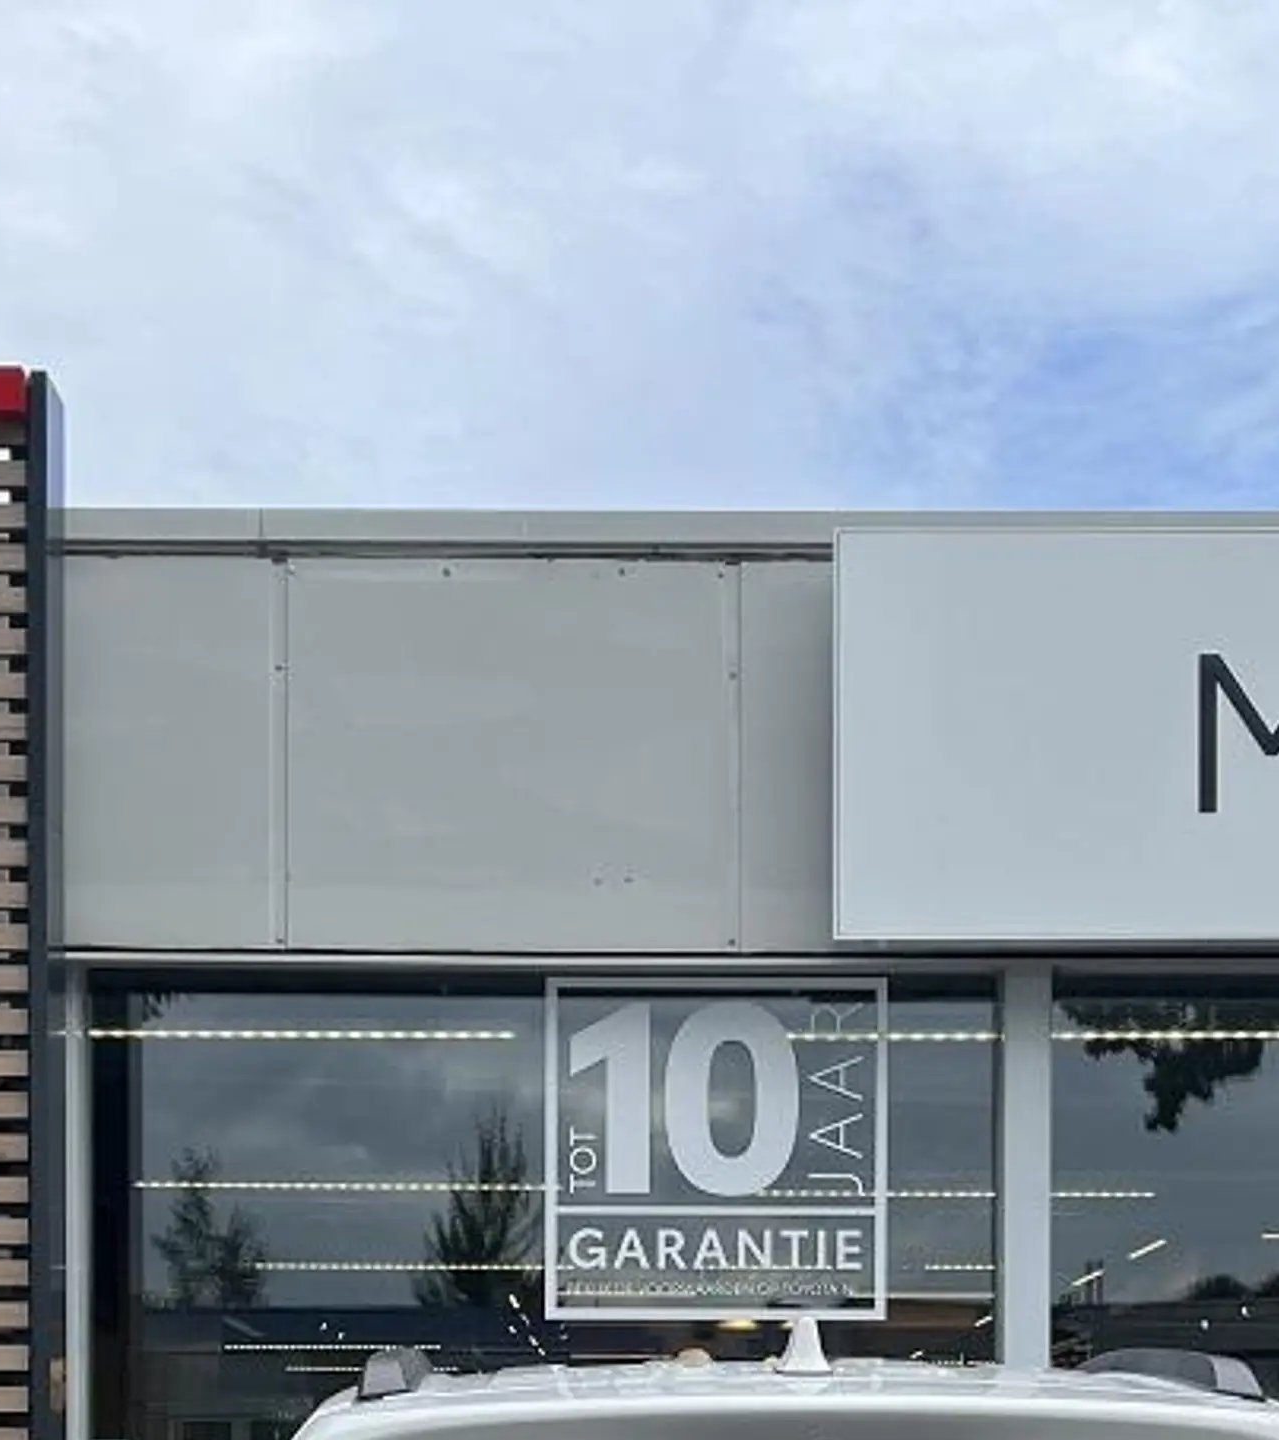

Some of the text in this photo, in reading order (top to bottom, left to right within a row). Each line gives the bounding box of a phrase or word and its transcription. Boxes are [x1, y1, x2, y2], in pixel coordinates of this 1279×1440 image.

[569, 1001, 799, 1197] 10
[569, 1126, 597, 1194] TOT
[807, 1001, 865, 1197] JAAR
[569, 1228, 864, 1270] GARANTIE
